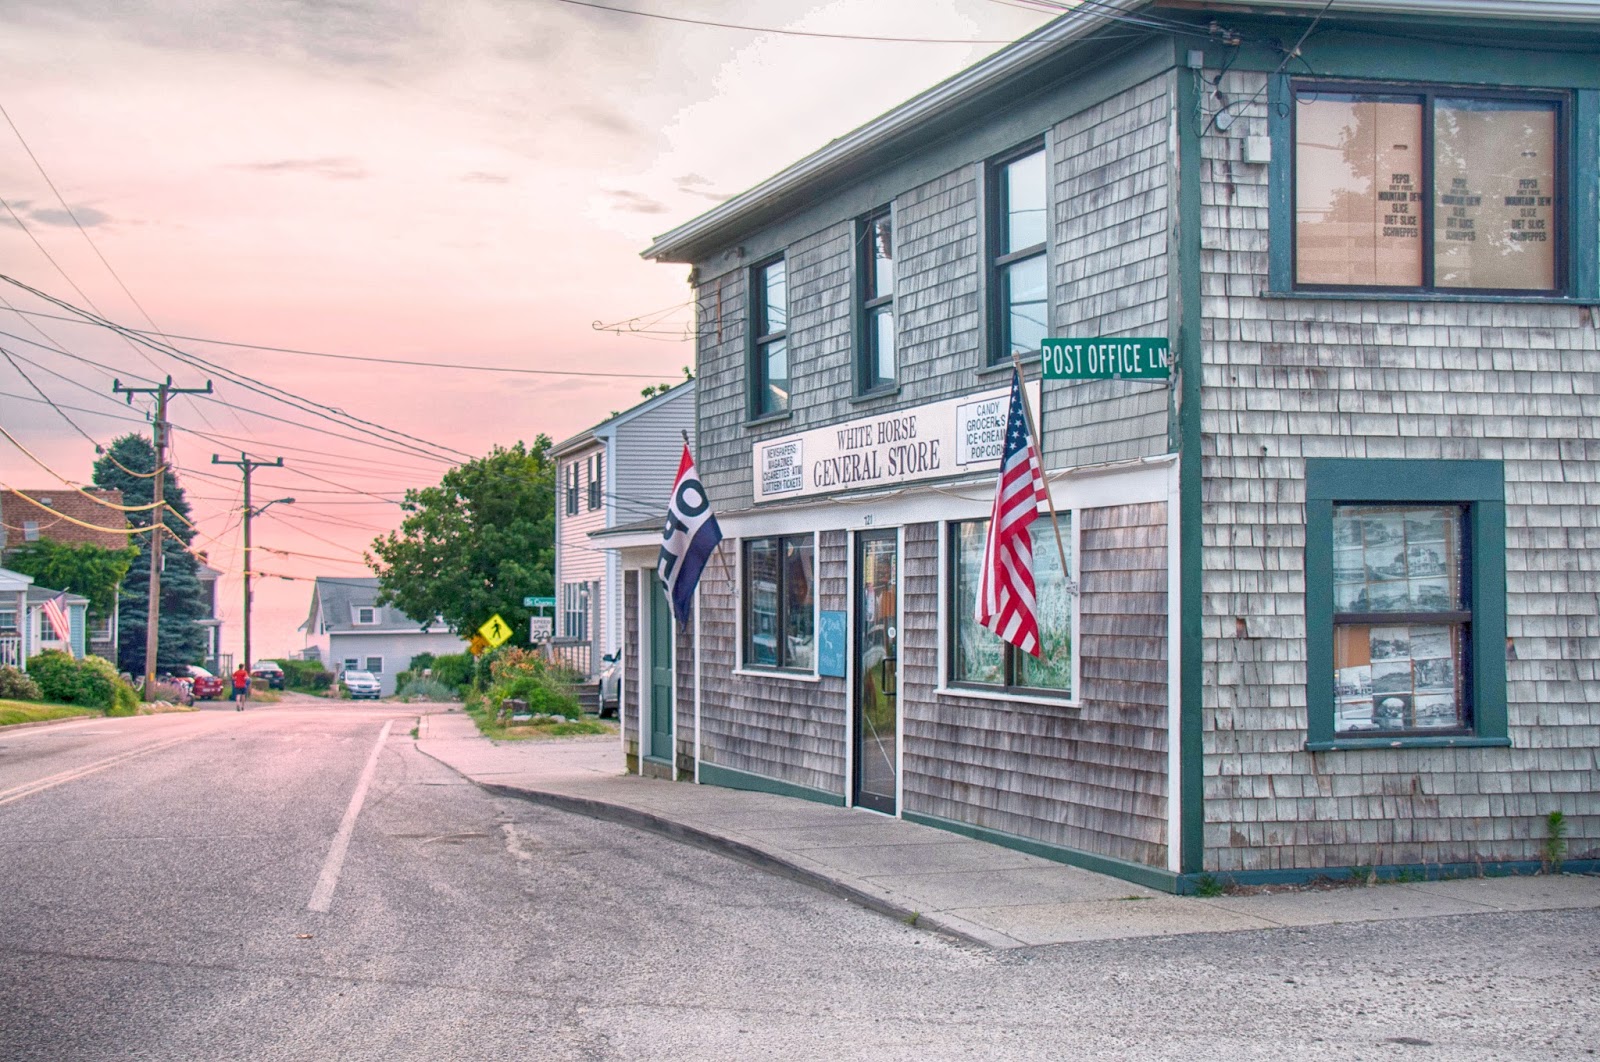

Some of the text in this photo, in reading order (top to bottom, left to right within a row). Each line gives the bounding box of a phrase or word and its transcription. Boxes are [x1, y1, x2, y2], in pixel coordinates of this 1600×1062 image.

[1392, 174, 1410, 184] PEPSI
[1519, 179, 1537, 189] PEPSI
[1378, 191, 1407, 201] MOUNTAIN
[1505, 196, 1552, 206] MOUNTAIN DEW
[1392, 203, 1408, 213] SLICE
[1520, 208, 1536, 218] SLICE
[1384, 215, 1417, 226] DIET SLICE
[1511, 219, 1545, 230] DIET SLICE
[1383, 226, 1418, 238] SCHWEPPES
[1042, 344, 1168, 375] POST OFFICE LN
[976, 401, 1000, 417] CANDY
[837, 415, 917, 450] WHITE HORSE
[767, 443, 797, 459] NEWSPAPERS
[768, 456, 793, 469] MAGAZINES
[814, 439, 941, 488] GENERAL STORE
[763, 477, 802, 493] LOTTERY TICKETS
[533, 630, 550, 640] 20
